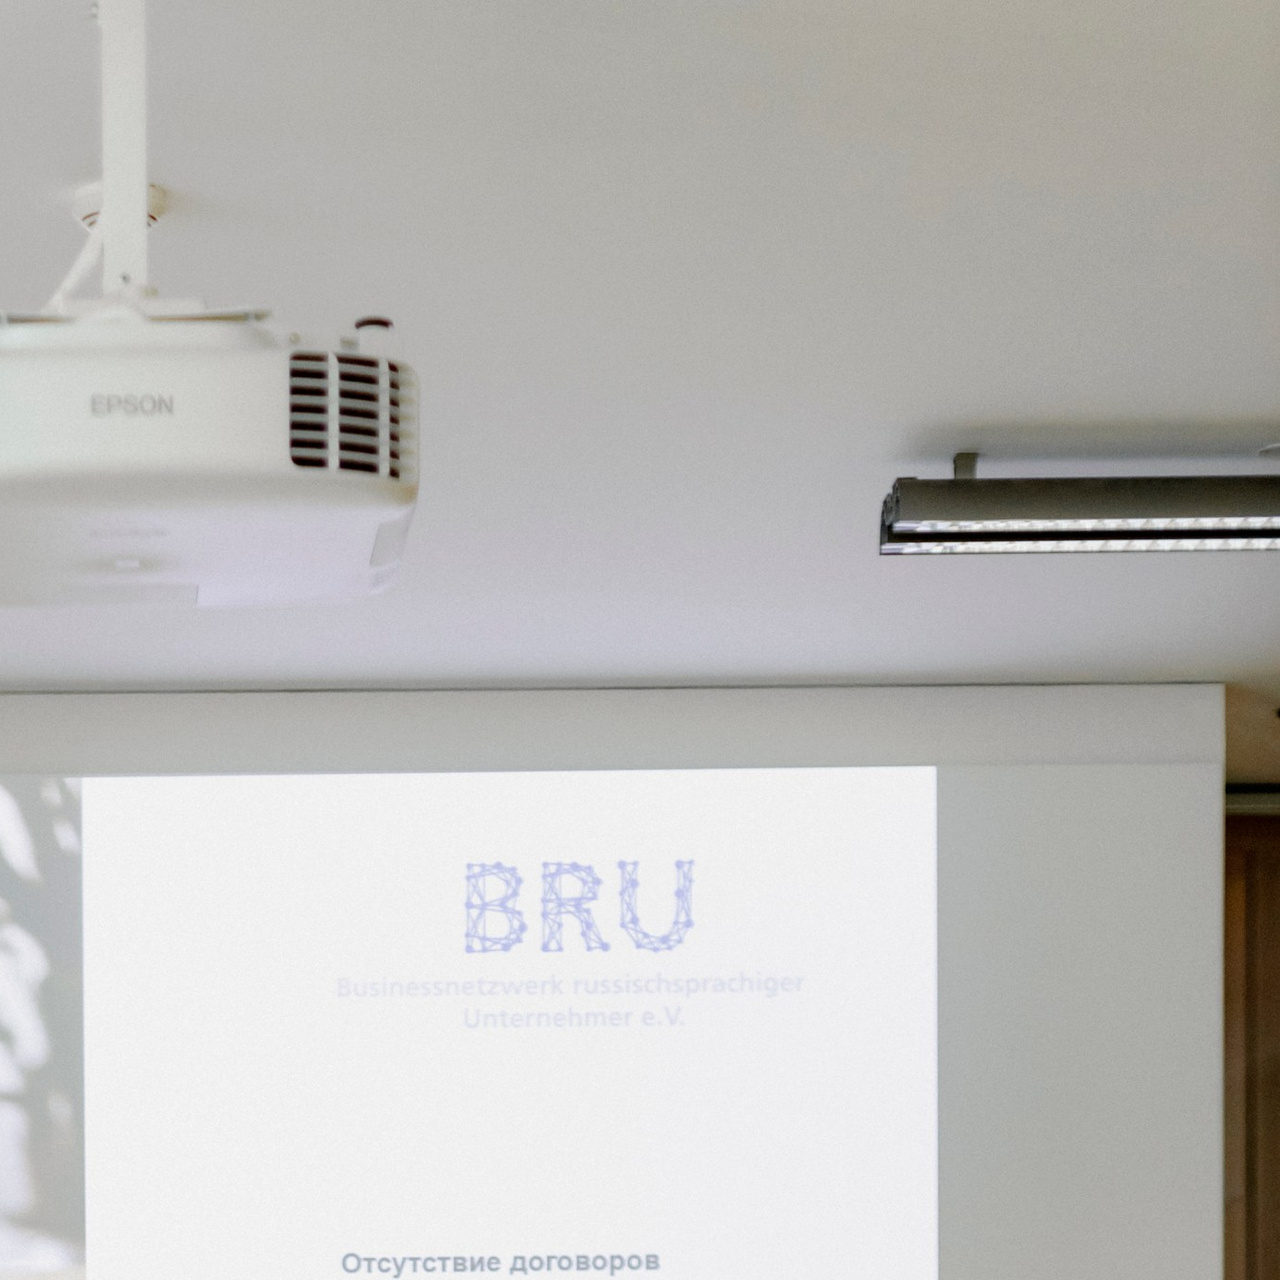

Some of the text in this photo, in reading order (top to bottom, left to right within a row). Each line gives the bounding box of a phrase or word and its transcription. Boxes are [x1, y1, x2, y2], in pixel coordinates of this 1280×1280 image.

[91, 395, 175, 417] EPSON
[463, 858, 696, 955] BRU
[336, 972, 805, 1000] Businessnetzwerk russischsprachiger
[463, 1005, 686, 1030] Unternehmer e.V.
[340, 1252, 661, 1280] Отсутствие договоров
